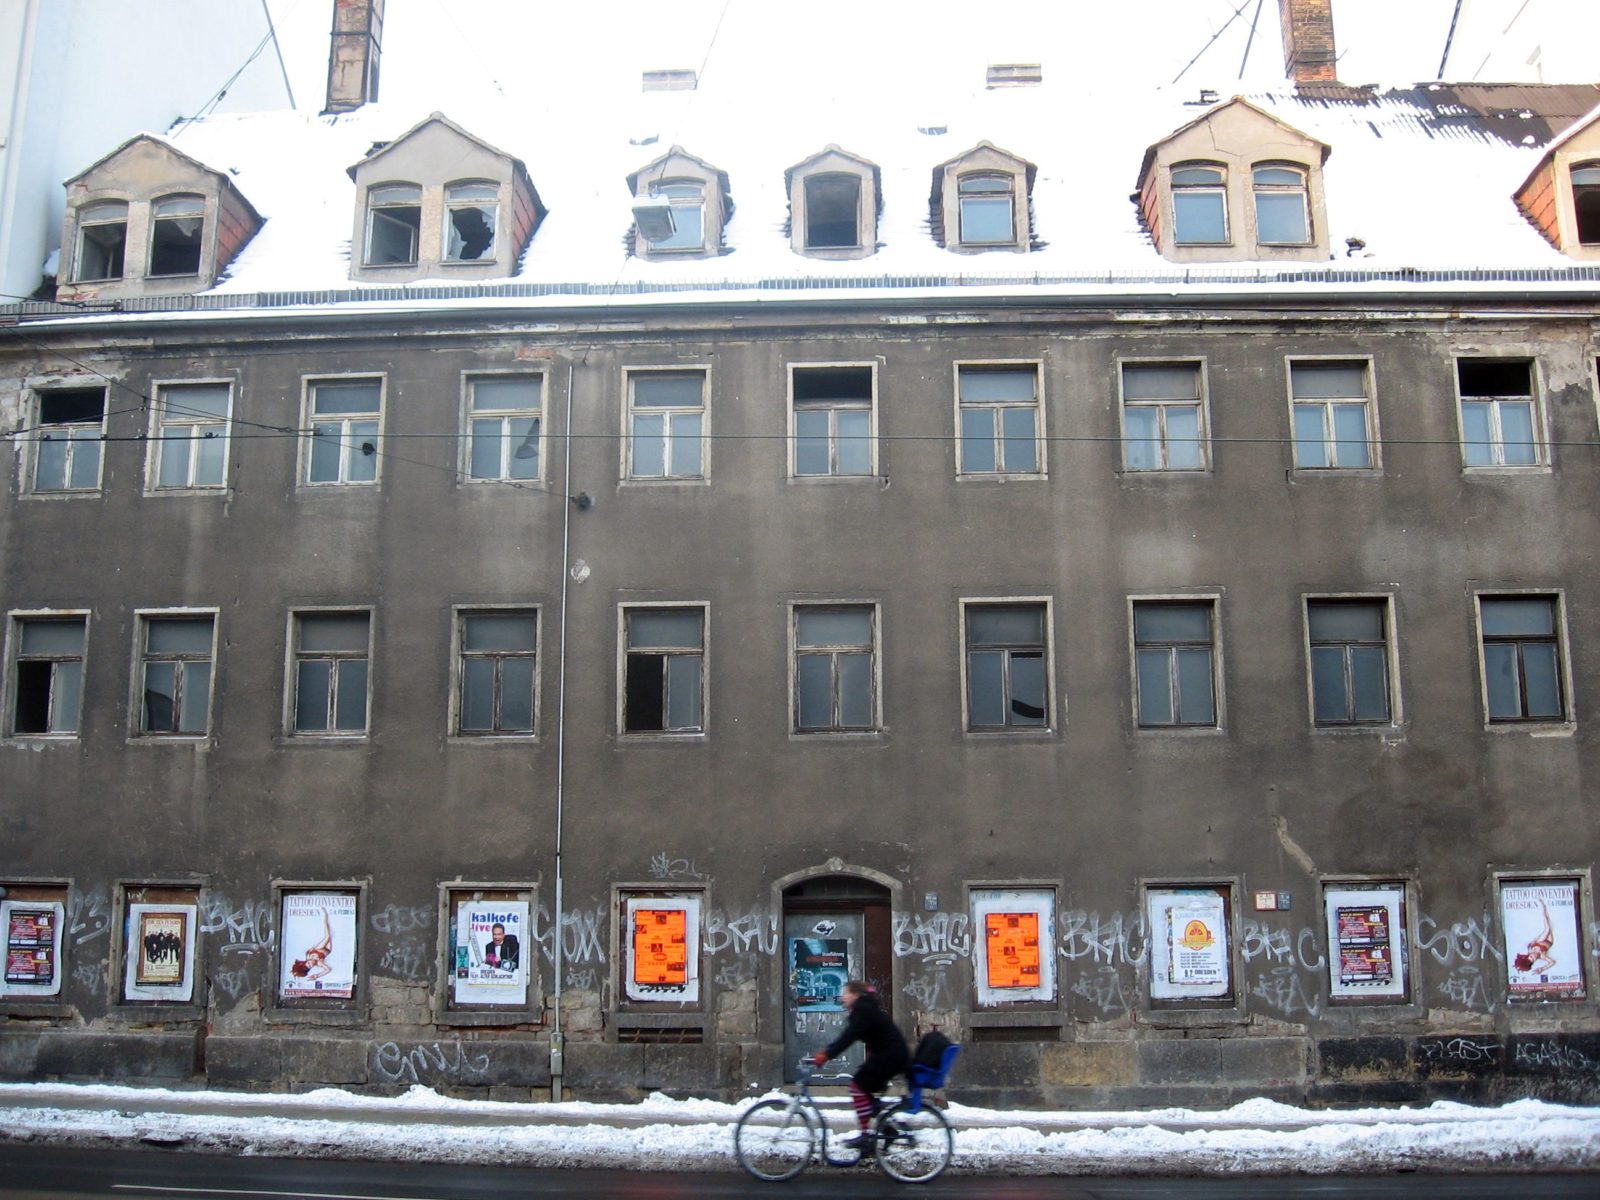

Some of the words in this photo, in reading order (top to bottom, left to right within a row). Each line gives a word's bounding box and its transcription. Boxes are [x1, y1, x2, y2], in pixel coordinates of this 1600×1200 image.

[1504, 888, 1531, 900] TATTOO
[1531, 887, 1574, 899] CONVENTION
[289, 896, 314, 907] TATTOO
[314, 896, 355, 908] CONVENTION
[1505, 900, 1539, 909] DRESDEN
[289, 908, 321, 916] DRESDEN
[471, 912, 519, 923] kalkofe
[471, 923, 491, 932] live
